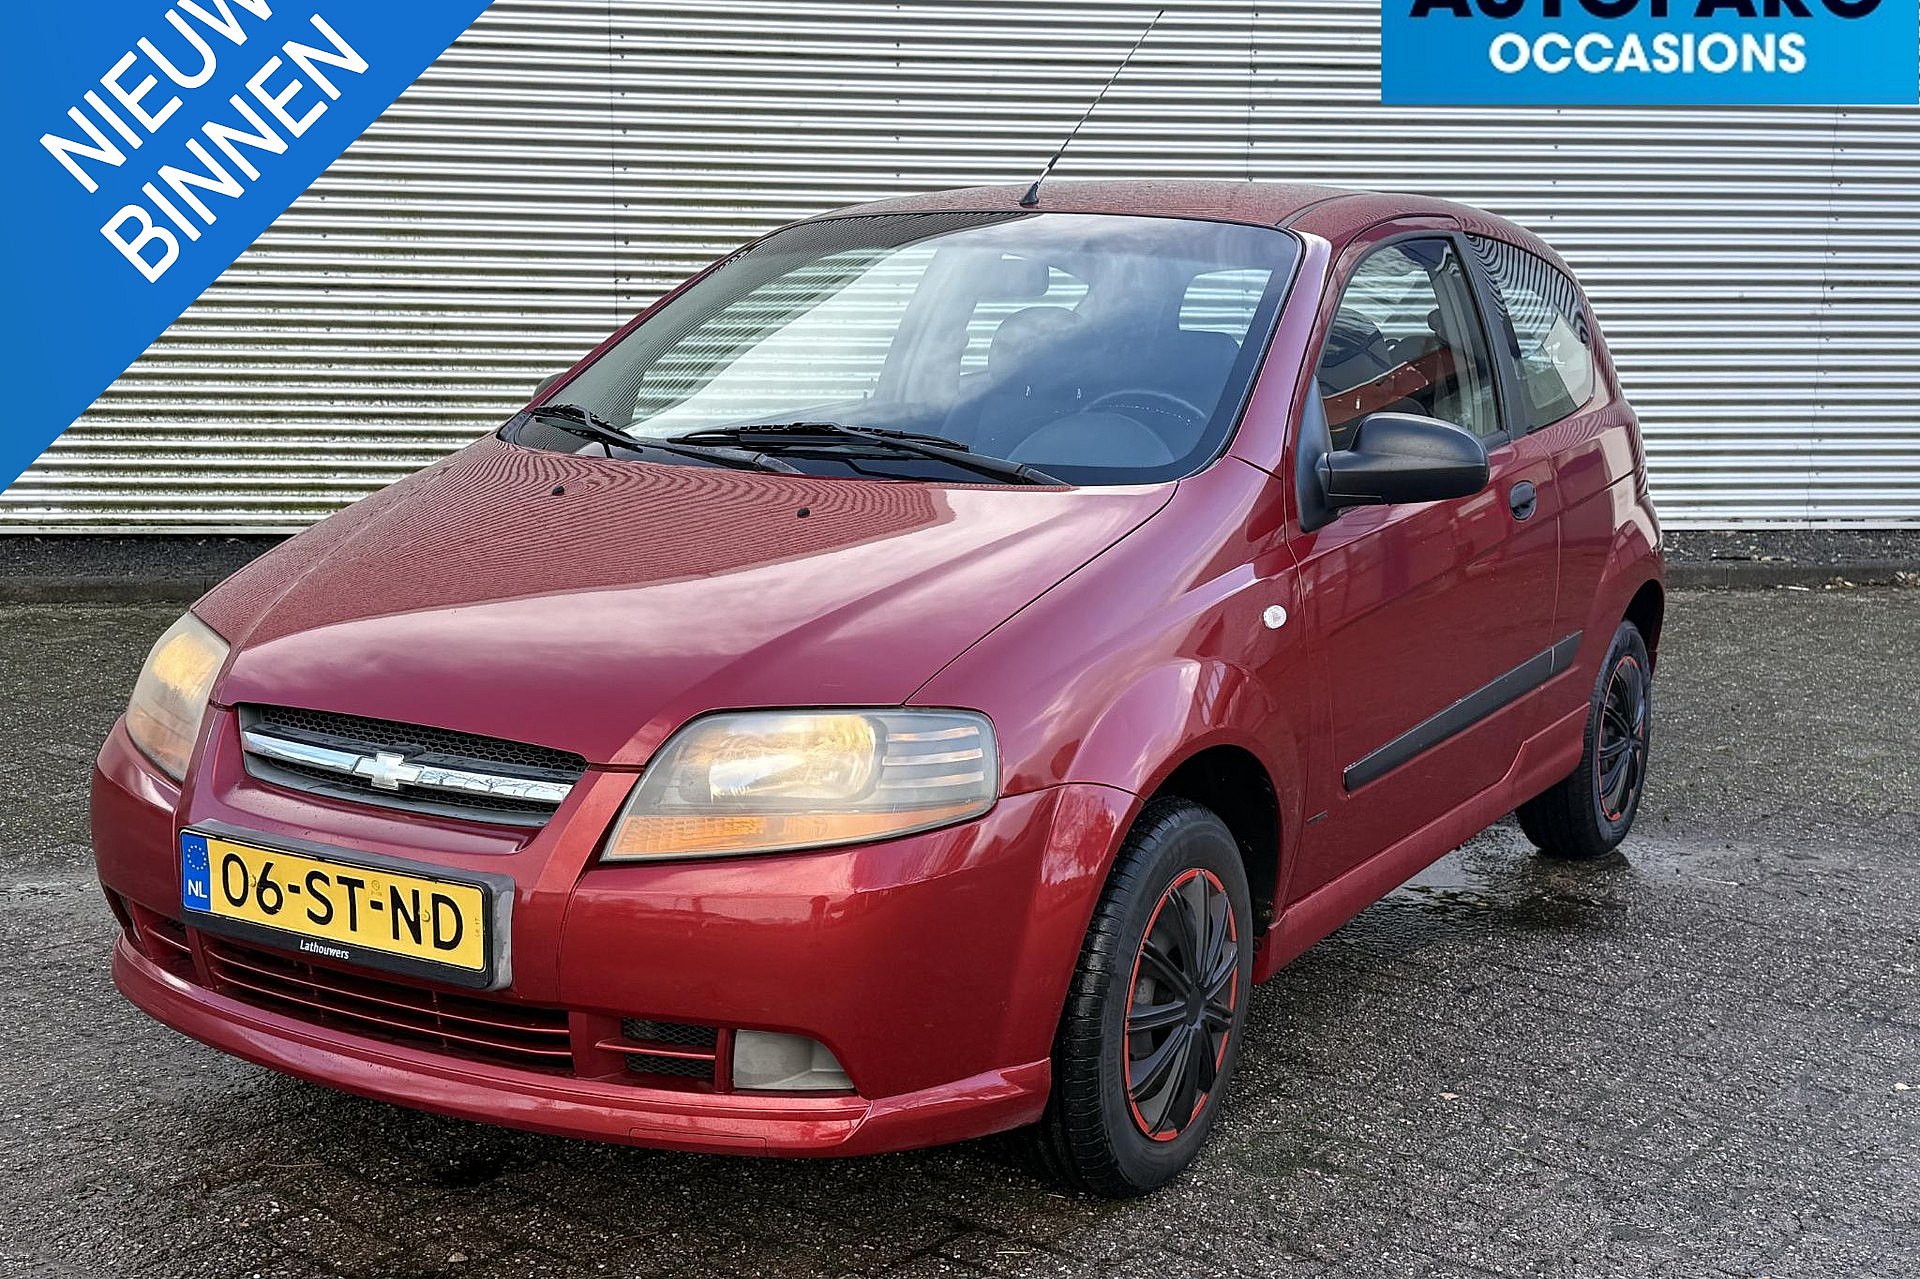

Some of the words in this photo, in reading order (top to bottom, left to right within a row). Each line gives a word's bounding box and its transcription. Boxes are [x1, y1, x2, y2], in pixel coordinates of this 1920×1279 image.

[187, 878, 208, 899] NL
[221, 853, 464, 951] 06-ST-ND
[299, 939, 350, 960] Lathouwers
